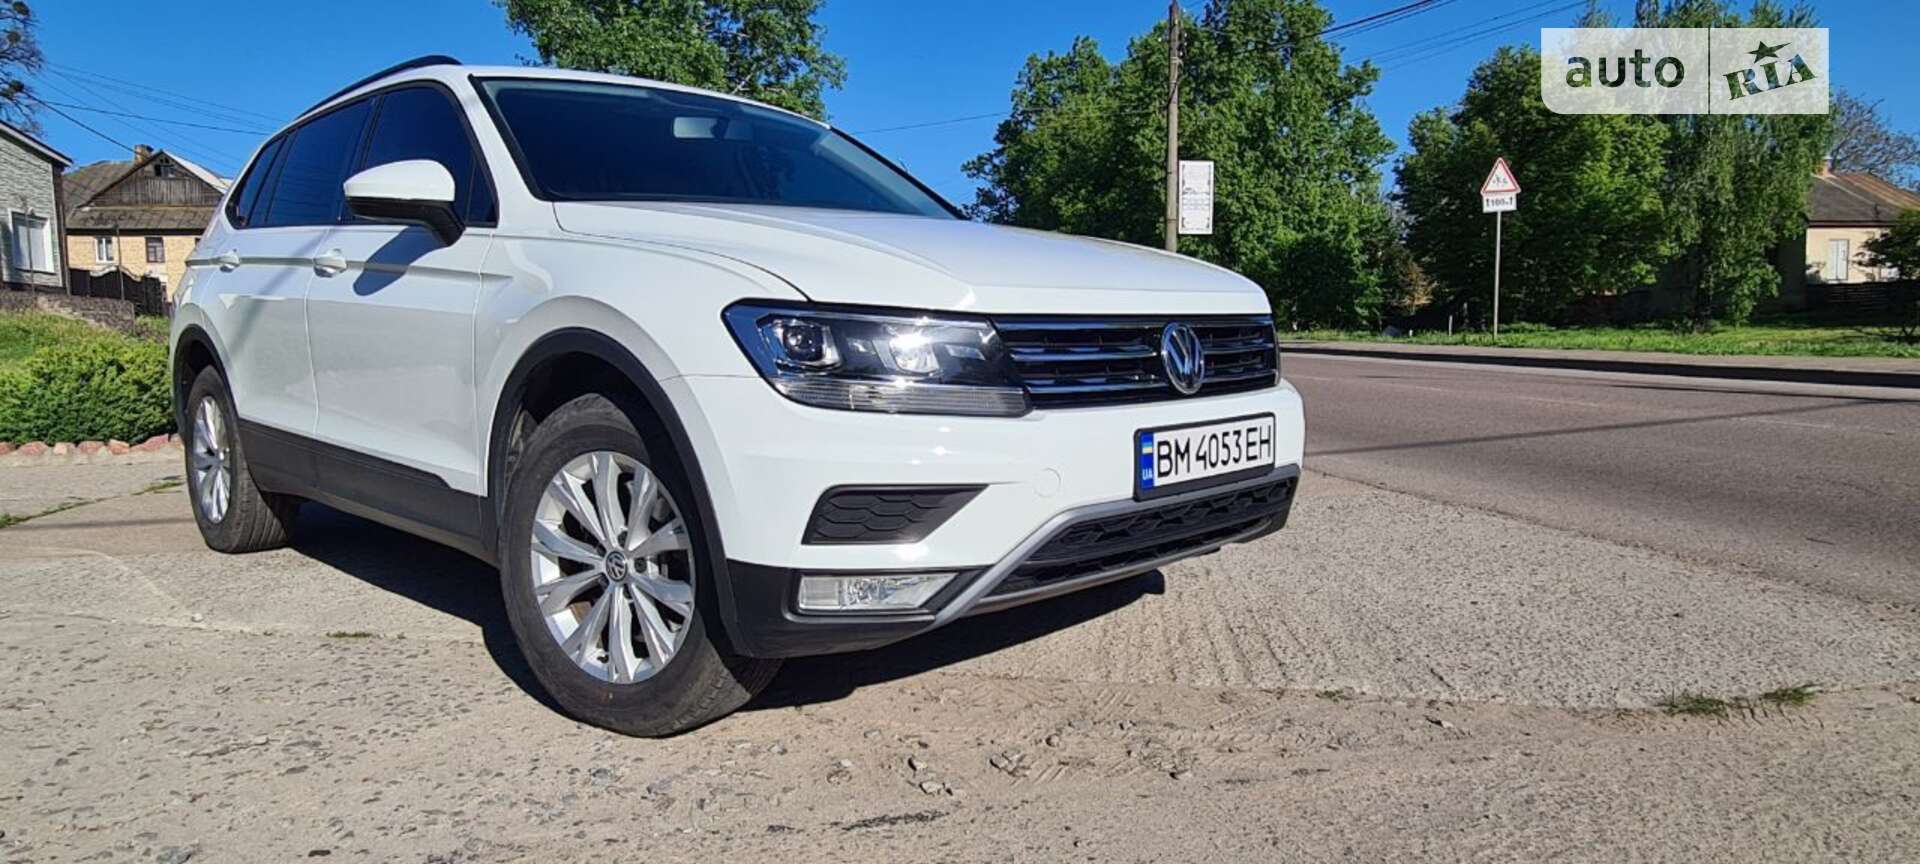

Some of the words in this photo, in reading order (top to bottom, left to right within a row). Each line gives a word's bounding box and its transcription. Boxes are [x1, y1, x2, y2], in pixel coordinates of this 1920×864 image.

[1157, 437, 1191, 478] BM
[1196, 430, 1242, 471] 4053
[1246, 425, 1271, 463] EH
[1141, 468, 1153, 481] UA
